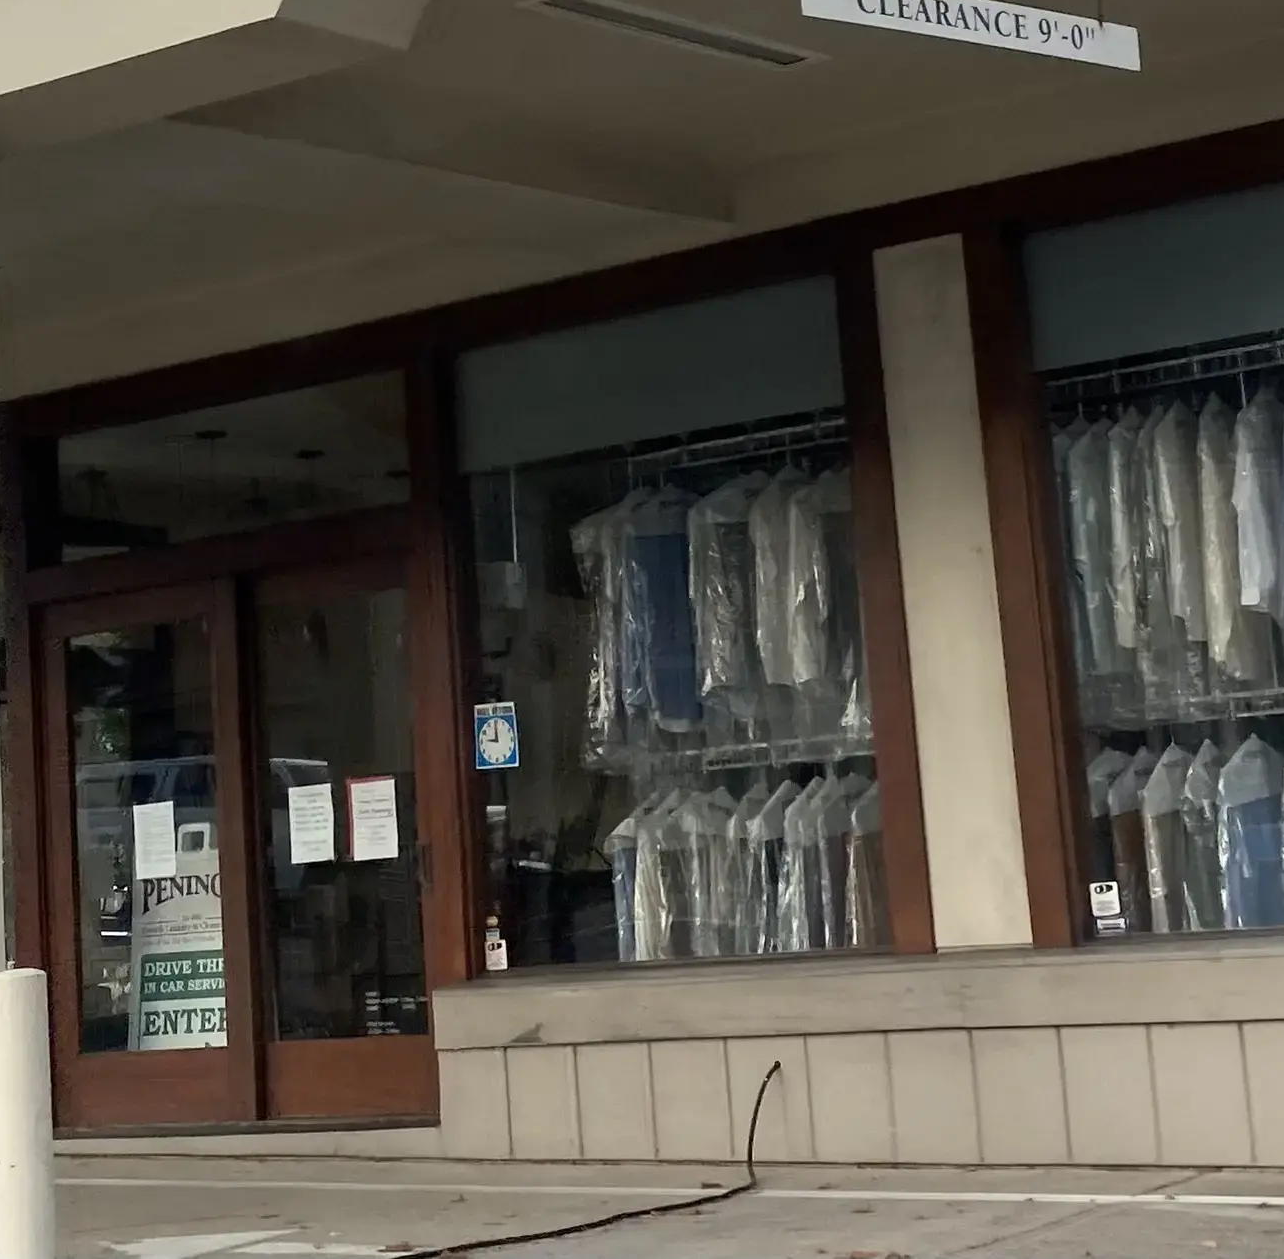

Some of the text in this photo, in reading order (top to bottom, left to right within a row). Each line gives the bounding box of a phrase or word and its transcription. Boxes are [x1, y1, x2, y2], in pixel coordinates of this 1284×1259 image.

[144, 959, 193, 978] DRIVE
[160, 980, 185, 994] CAR
[187, 977, 226, 991] SERVI
